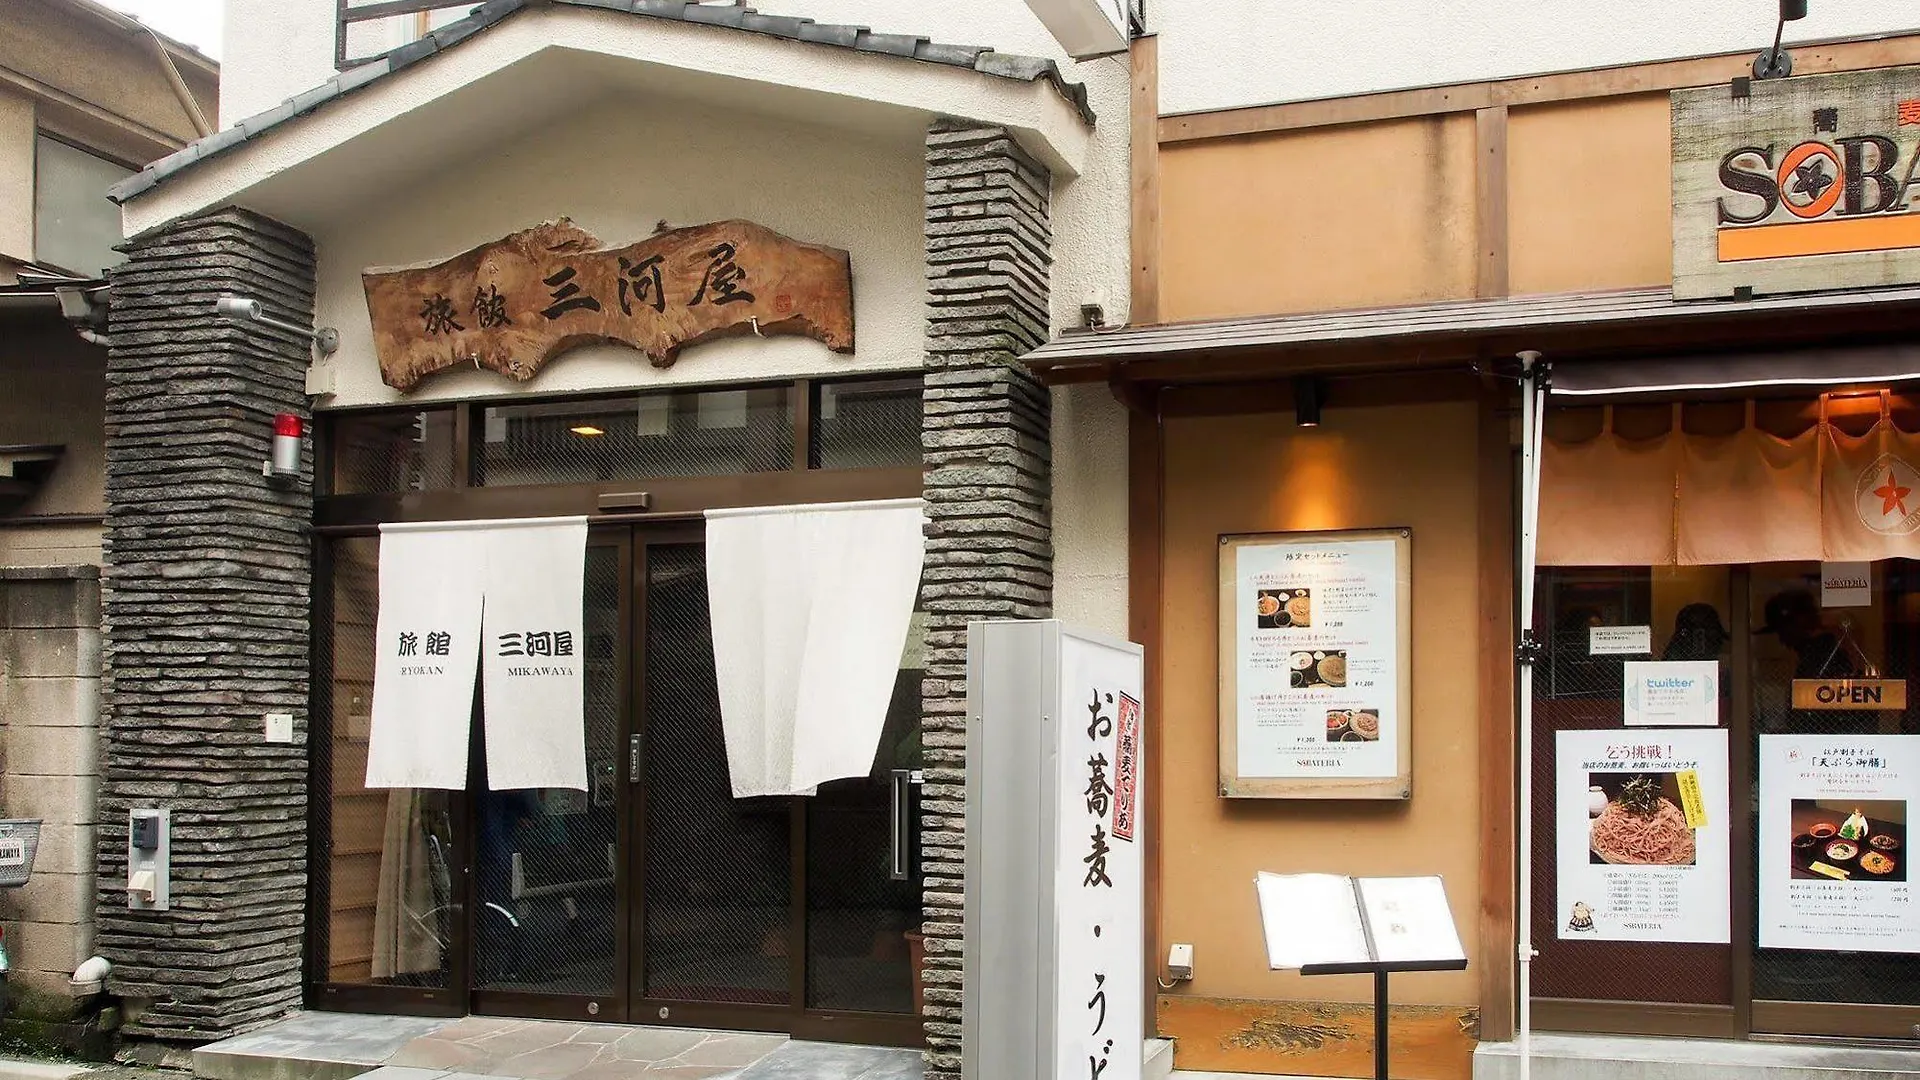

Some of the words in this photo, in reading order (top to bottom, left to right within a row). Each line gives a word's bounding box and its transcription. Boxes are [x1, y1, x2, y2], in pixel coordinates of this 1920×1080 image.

[540, 242, 756, 320] 三河屋
[398, 630, 452, 657] 旅館
[499, 630, 574, 657] 三河屋
[400, 666, 444, 676] RYOKAN
[508, 666, 574, 677] MIKAWAYA
[1646, 678, 1694, 690] twitter
[1816, 685, 1882, 704] OPEN
